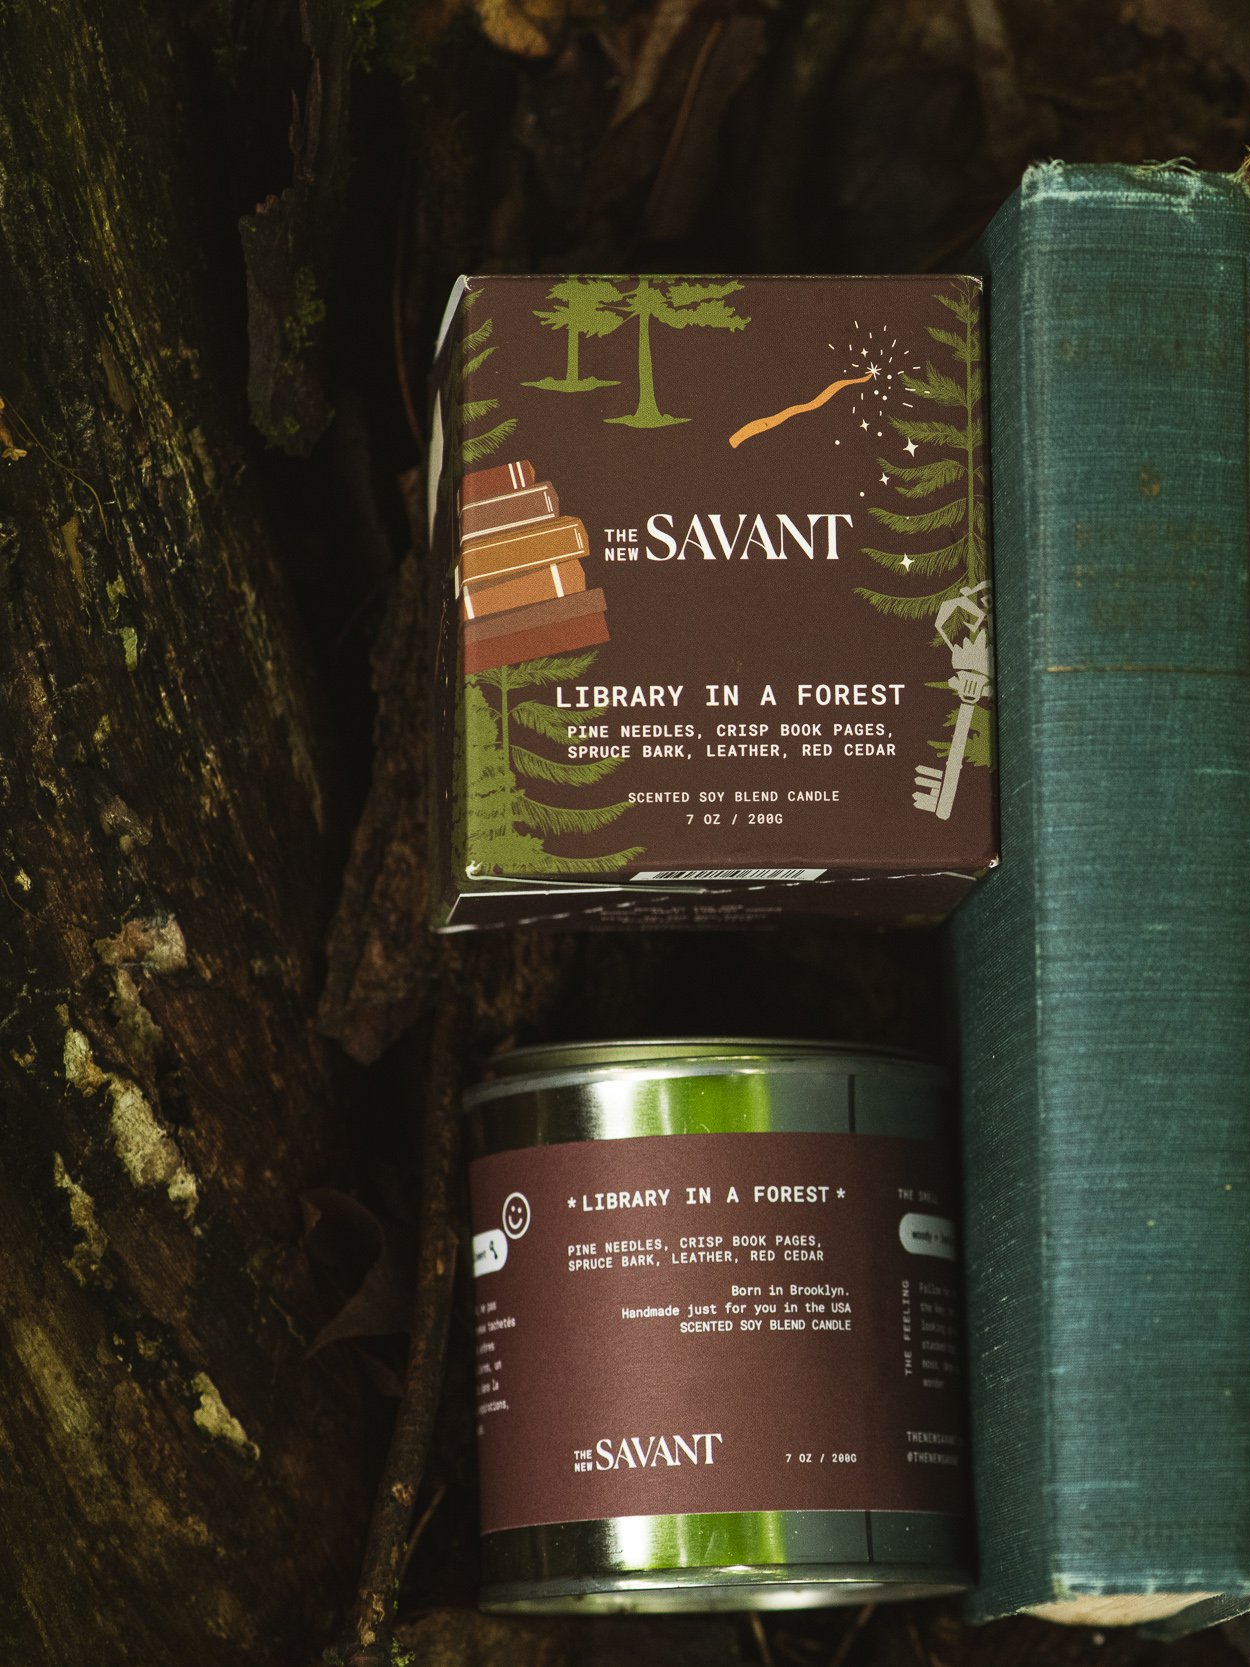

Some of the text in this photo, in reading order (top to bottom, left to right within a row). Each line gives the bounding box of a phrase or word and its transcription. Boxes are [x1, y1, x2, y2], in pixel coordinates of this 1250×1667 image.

[604, 529, 637, 542] THE
[646, 514, 853, 561] SAVANT
[605, 548, 638, 561] NEW
[557, 684, 905, 707] LIBRARY IN A FOREST
[568, 724, 891, 739] PINE NEEDLES, CRISP BOOK PAGES,
[568, 744, 895, 759] SPRUCE BARK, LEATHER, RED CEDAR
[629, 791, 839, 803] SCENTED SOY BLEND CANDLE
[687, 814, 782, 825] 7 OZ / 200G
[583, 1186, 829, 1211] LIBRARY IN A FOREST
[568, 1235, 820, 1256] PINE NEEDLES, CRISP BOOK PAGES,
[569, 1250, 823, 1271] SPRUCE BARK, LEATHER, RED CEDAR
[732, 1284, 848, 1298] Born in Brooklyn.
[622, 1302, 851, 1318] Handmade just for you in the USA
[680, 1319, 850, 1333] SCENTED SOY BLEND CANDLE
[901, 1280, 913, 1376] THE FEELING
[574, 1450, 592, 1459] THE
[596, 1434, 722, 1470] SAVANT
[786, 1453, 856, 1463] 7 OZ / 200G
[575, 1462, 592, 1472] NEW
